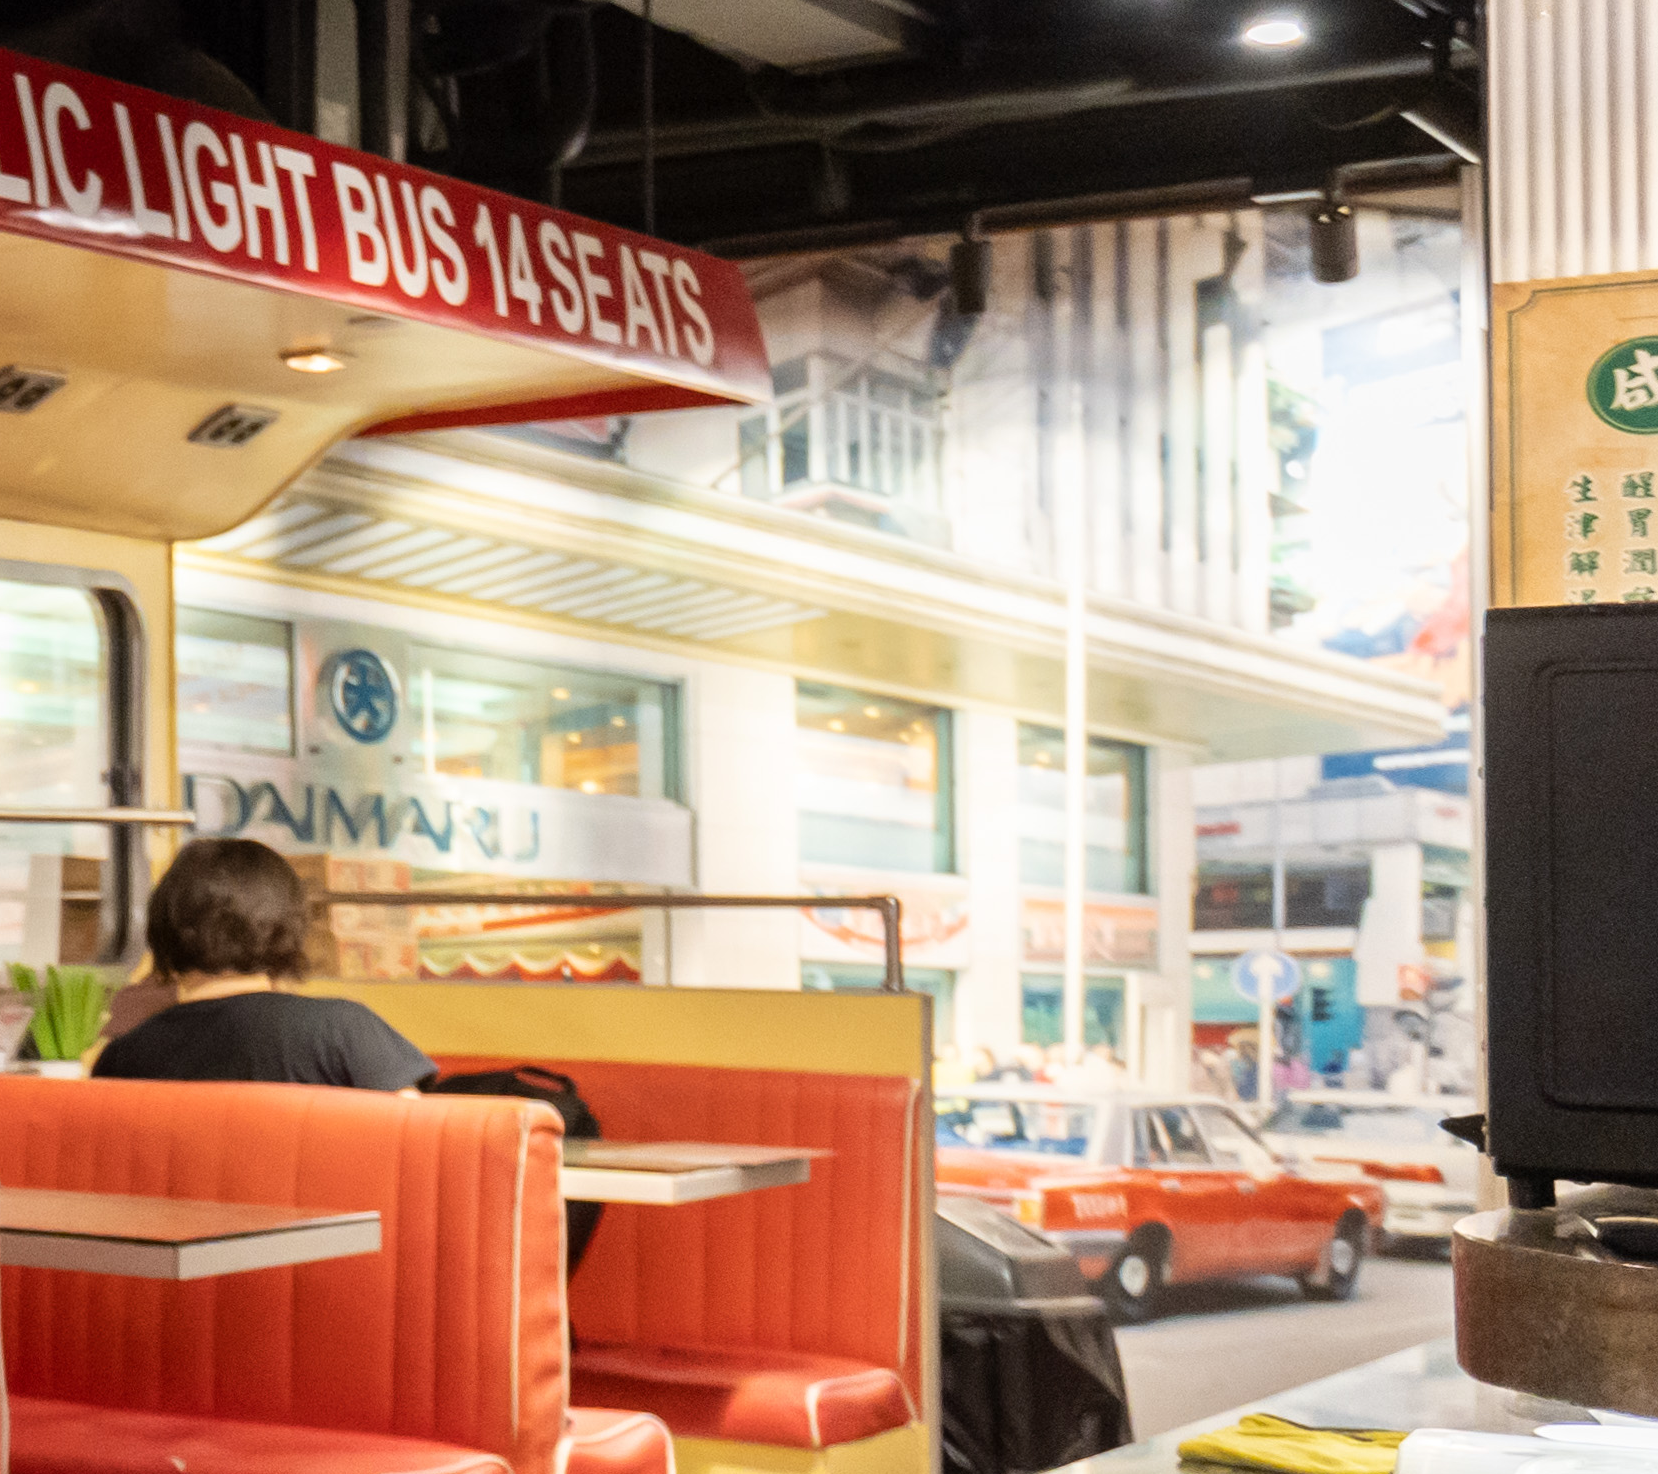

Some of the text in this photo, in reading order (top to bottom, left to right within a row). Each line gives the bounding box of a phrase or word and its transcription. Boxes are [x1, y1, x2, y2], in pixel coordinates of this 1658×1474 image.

[112, 102, 322, 274] LIGHT
[333, 163, 471, 308] BUS
[473, 203, 541, 326] 14
[538, 213, 715, 365] SEATS
